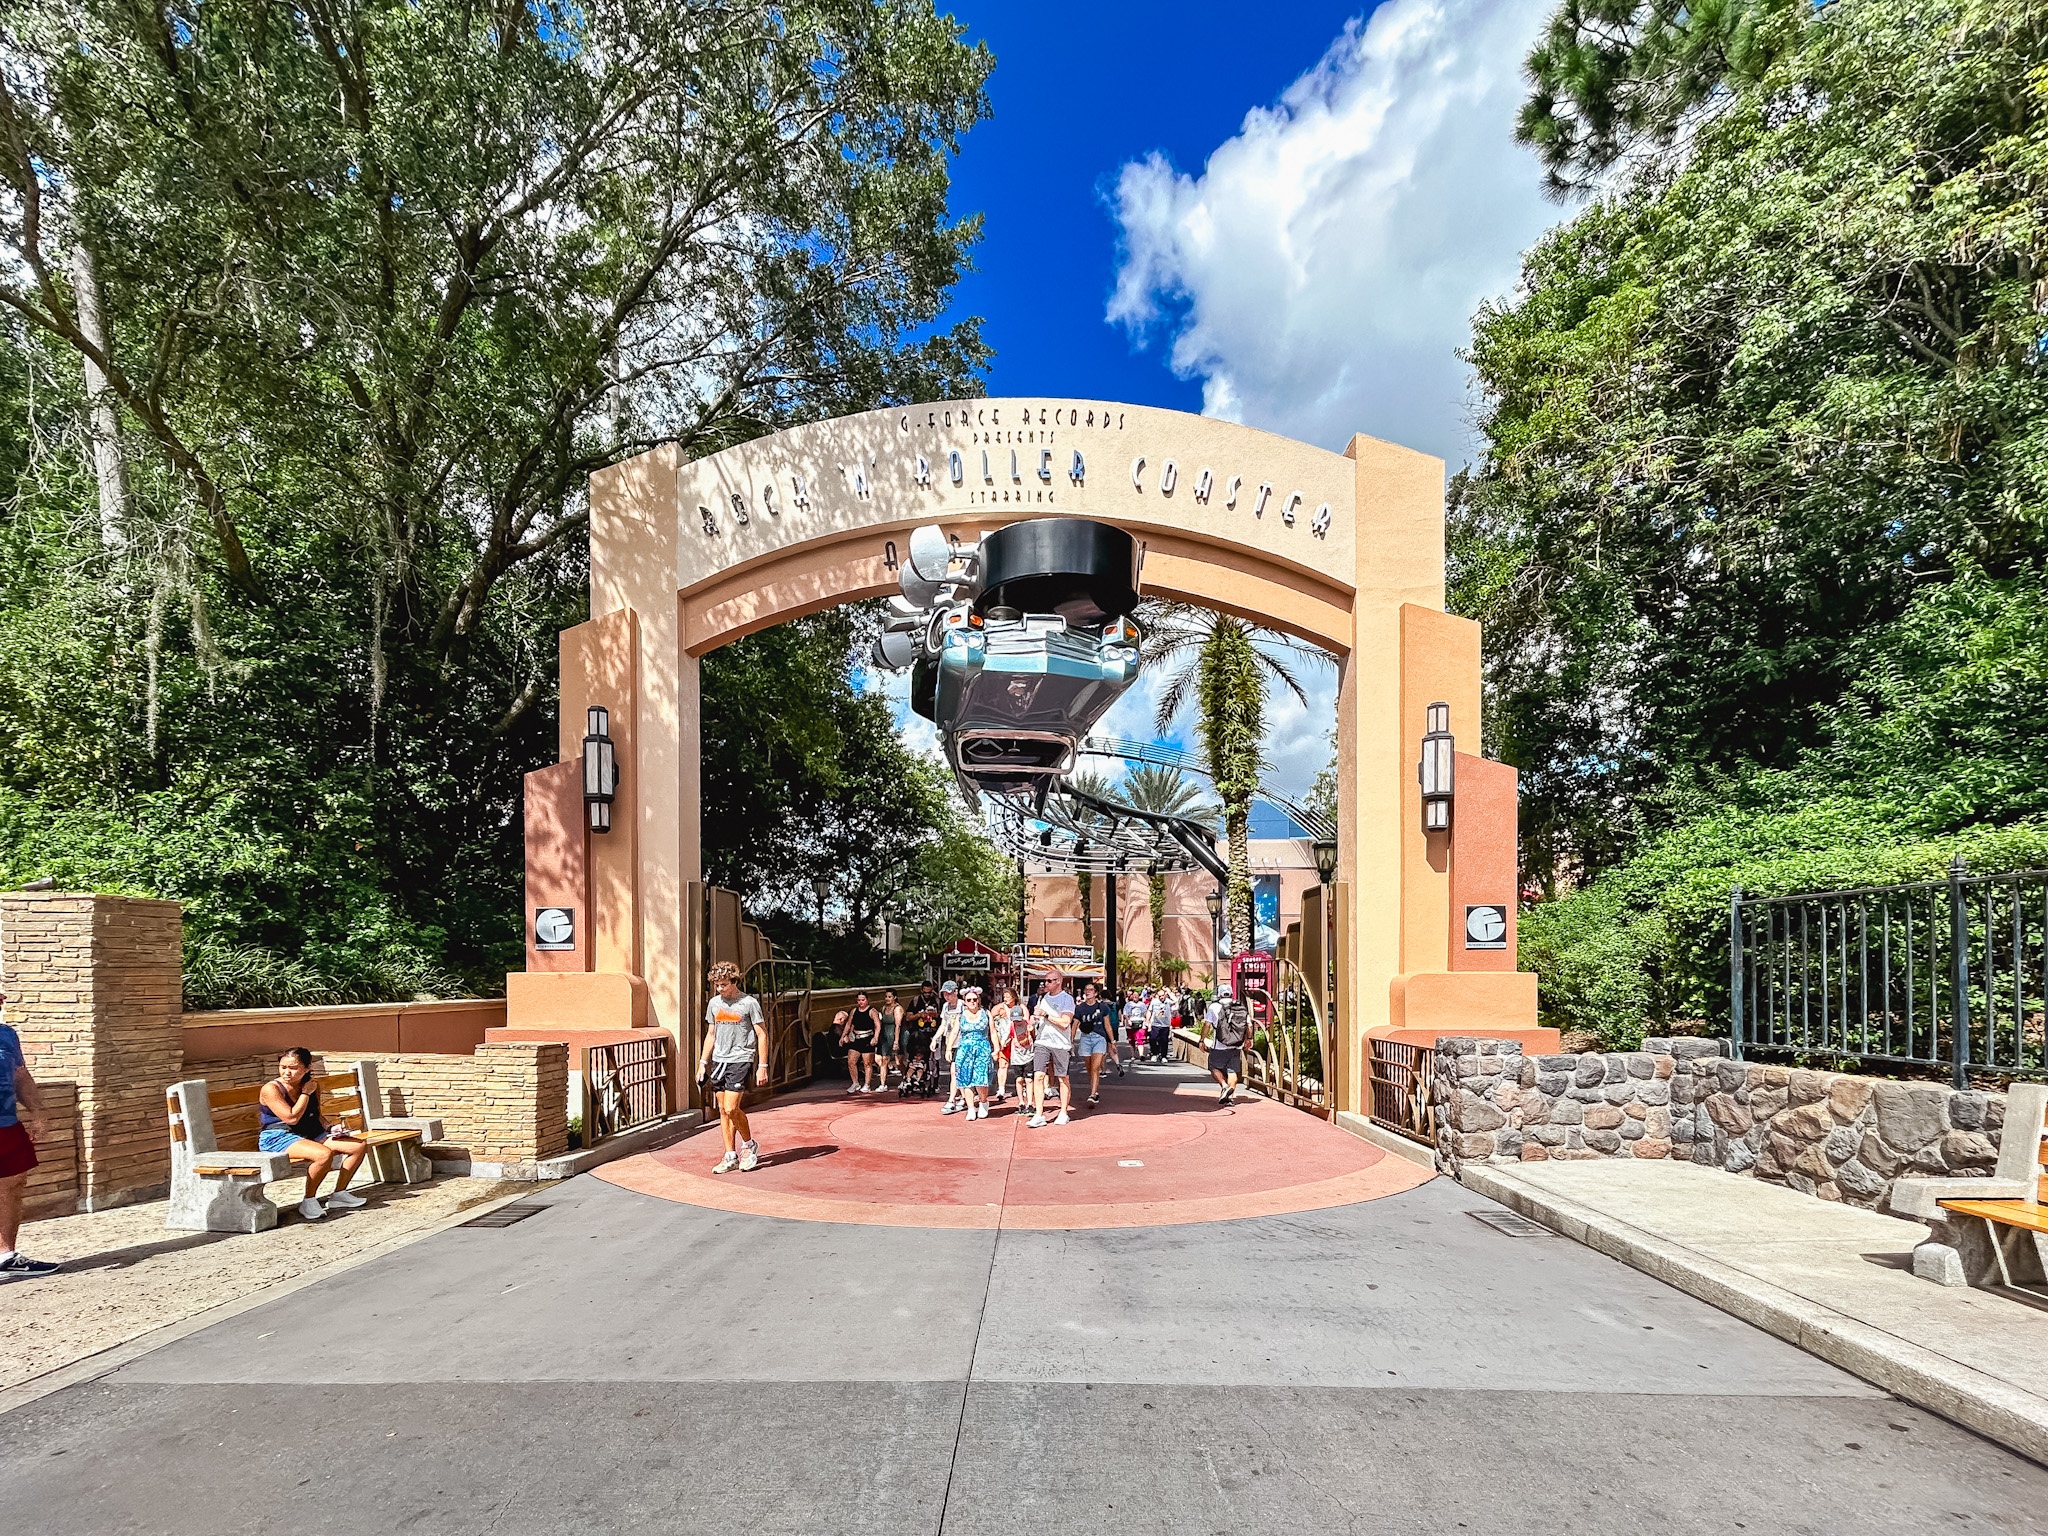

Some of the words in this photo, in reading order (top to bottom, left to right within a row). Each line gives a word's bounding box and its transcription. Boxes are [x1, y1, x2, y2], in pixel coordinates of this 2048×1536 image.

[1022, 407, 1125, 430] RECORDS
[972, 431, 1054, 445] PRESENTS
[699, 474, 812, 539] ROCK
[914, 449, 1085, 491] ROLLER
[1131, 456, 1333, 540] COASTER
[970, 489, 1054, 504] STARRING
